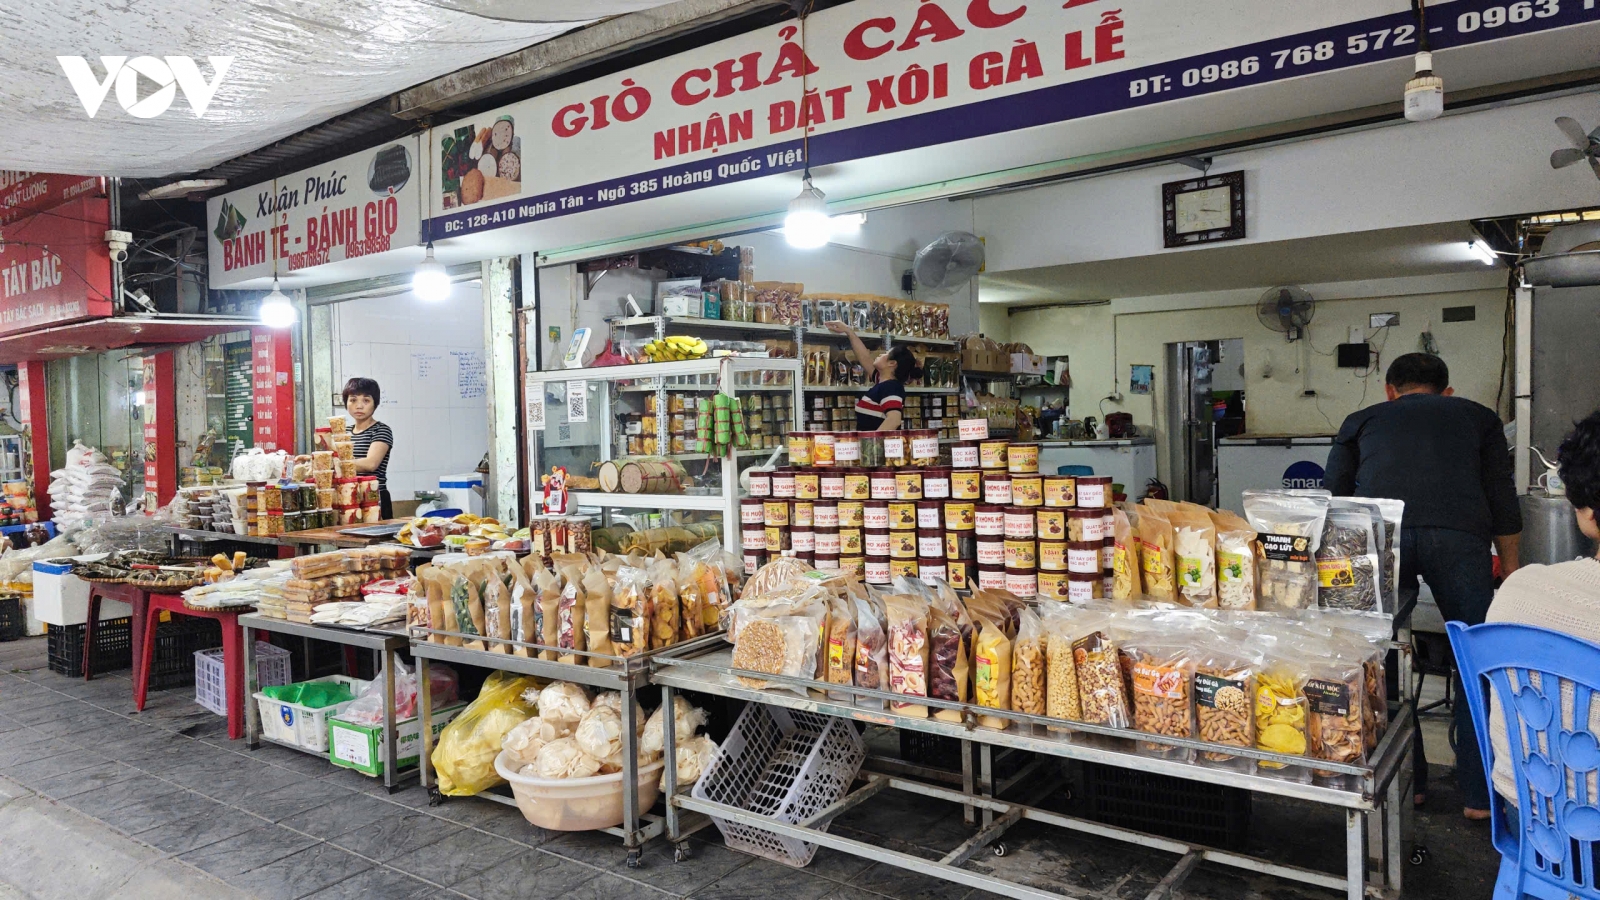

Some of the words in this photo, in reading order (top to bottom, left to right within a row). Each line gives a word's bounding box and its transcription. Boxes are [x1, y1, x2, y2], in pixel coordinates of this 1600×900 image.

[1129, 73, 1172, 98] ĐT:
[1182, 53, 1260, 87] 0986
[1271, 42, 1335, 71] 768
[1347, 25, 1416, 55] 572
[1457, 0, 1560, 33] 0963
[551, 78, 651, 138] GIÒ
[671, 25, 819, 105] CHẢ
[653, 109, 753, 160] NHẬN
[767, 85, 853, 133] ĐẶT
[867, 63, 948, 113] XÔI
[969, 38, 1043, 90] GÀ
[1064, 8, 1125, 71] LỄ
[257, 186, 299, 218] Xuân
[304, 170, 348, 205] Phúc
[445, 217, 464, 233] ĐC:
[466, 208, 516, 230] 128-A10
[519, 197, 556, 219] Nghĩa
[560, 192, 584, 211] Tân
[597, 182, 626, 203] Ngõ
[630, 177, 658, 197] 385
[662, 167, 713, 192] Hoàng
[717, 156, 761, 180] Quốc
[767, 148, 803, 168] Việt
[223, 228, 266, 271] BÁNH
[271, 212, 289, 260] TẺ
[307, 205, 358, 252] BÁNH
[364, 186, 398, 240] GIÒ
[2, 260, 27, 297] TÂY
[31, 245, 62, 291] BẮC
[288, 246, 330, 271] 0986768572
[1282, 477, 1324, 489] smar
[1264, 543, 1278, 551] GẠO
[1279, 543, 1293, 551] LỨT
[1266, 535, 1291, 543] THANH
